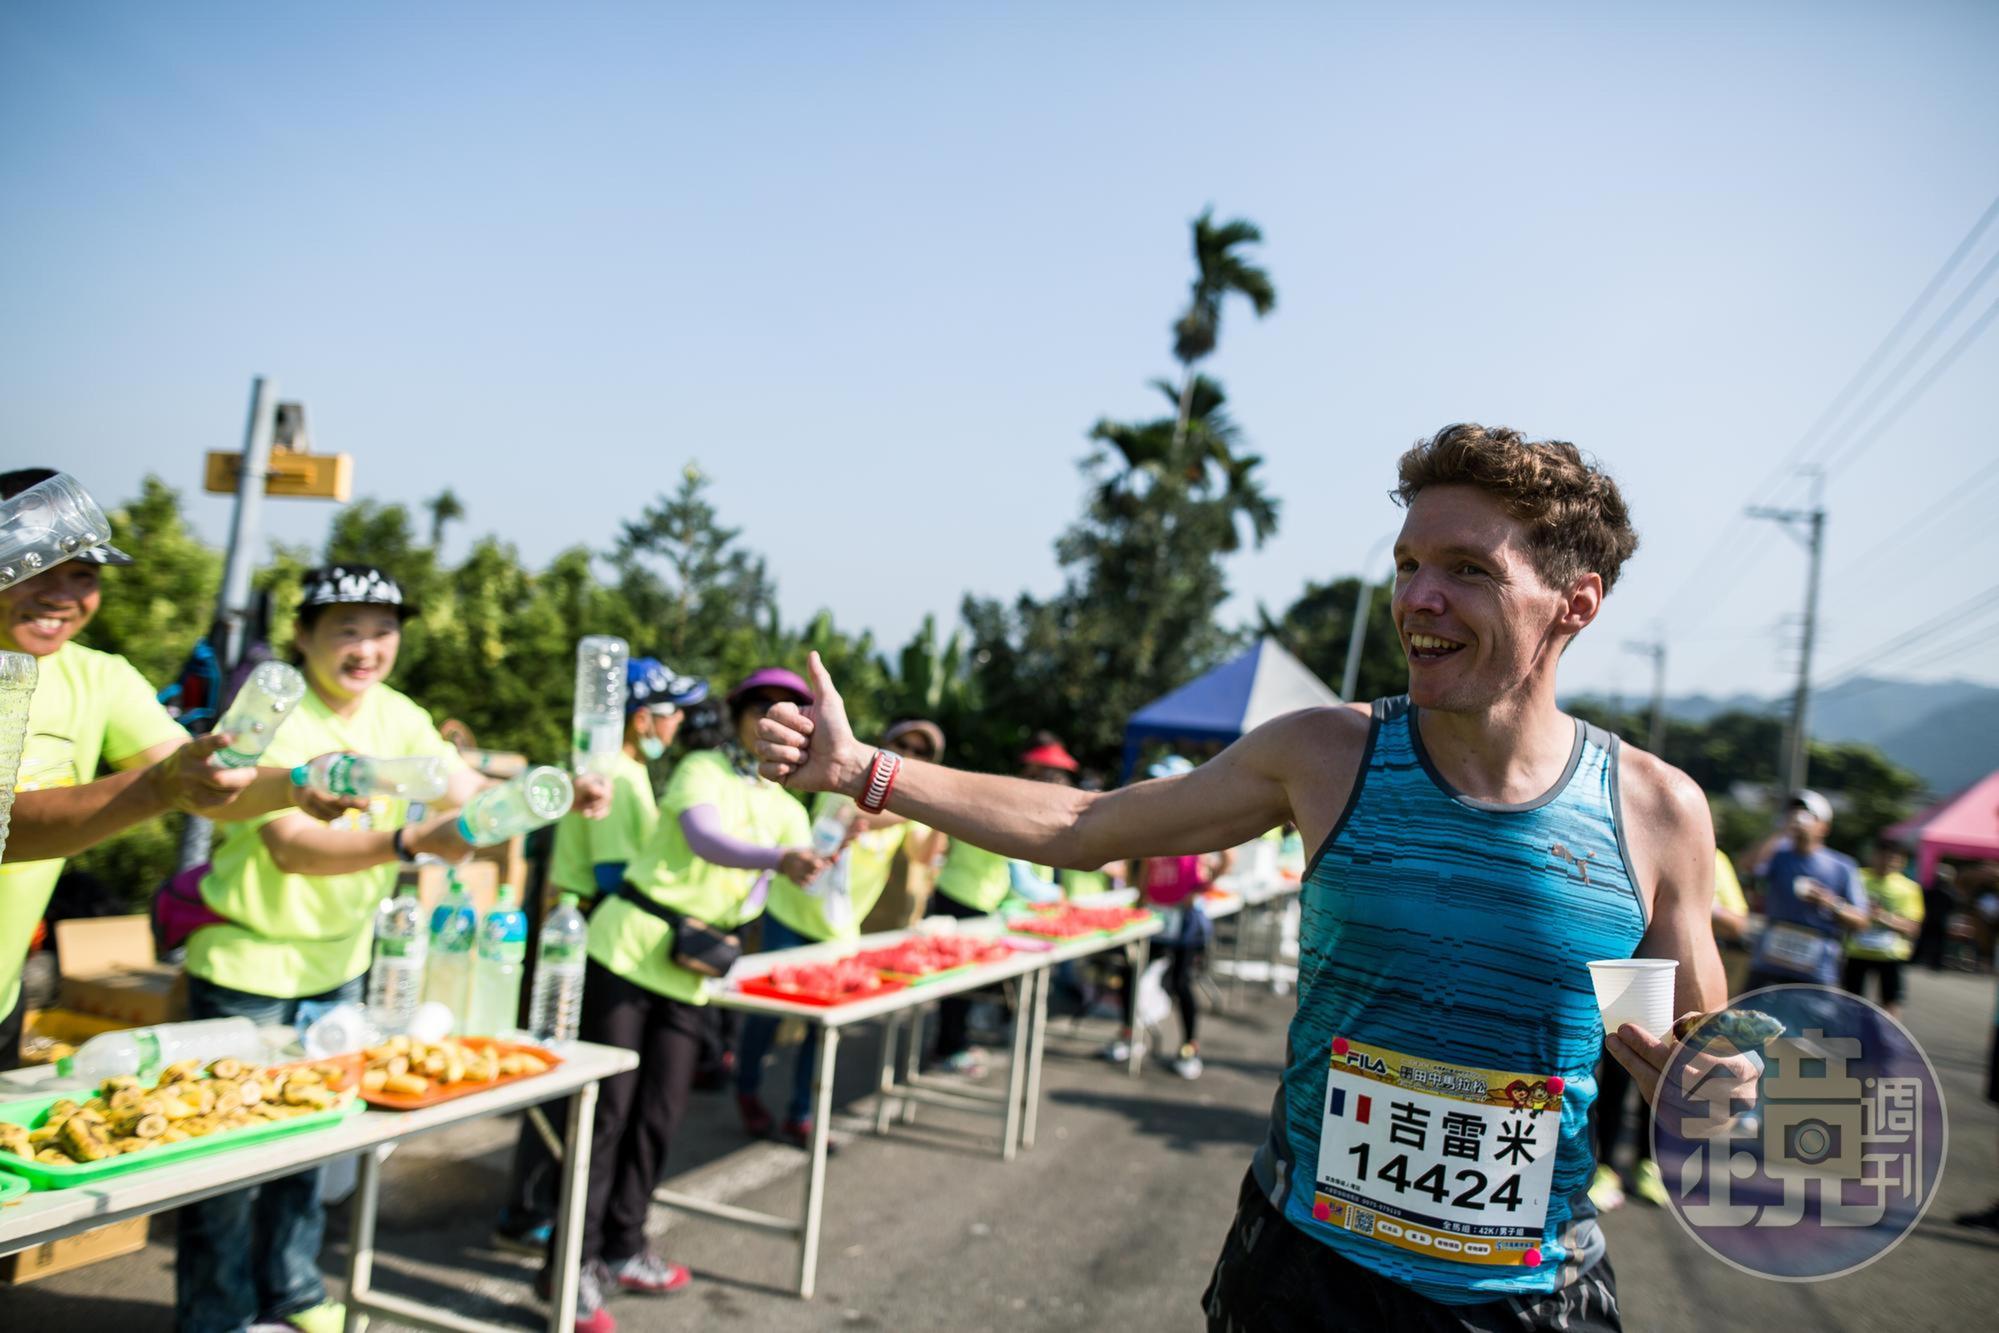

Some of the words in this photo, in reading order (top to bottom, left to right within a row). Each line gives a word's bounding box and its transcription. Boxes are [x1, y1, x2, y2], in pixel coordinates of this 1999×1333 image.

[1346, 1051, 1387, 1074] FILA
[1390, 1101, 1537, 1166] 吉雷米
[1348, 1142, 1523, 1212] 14424
